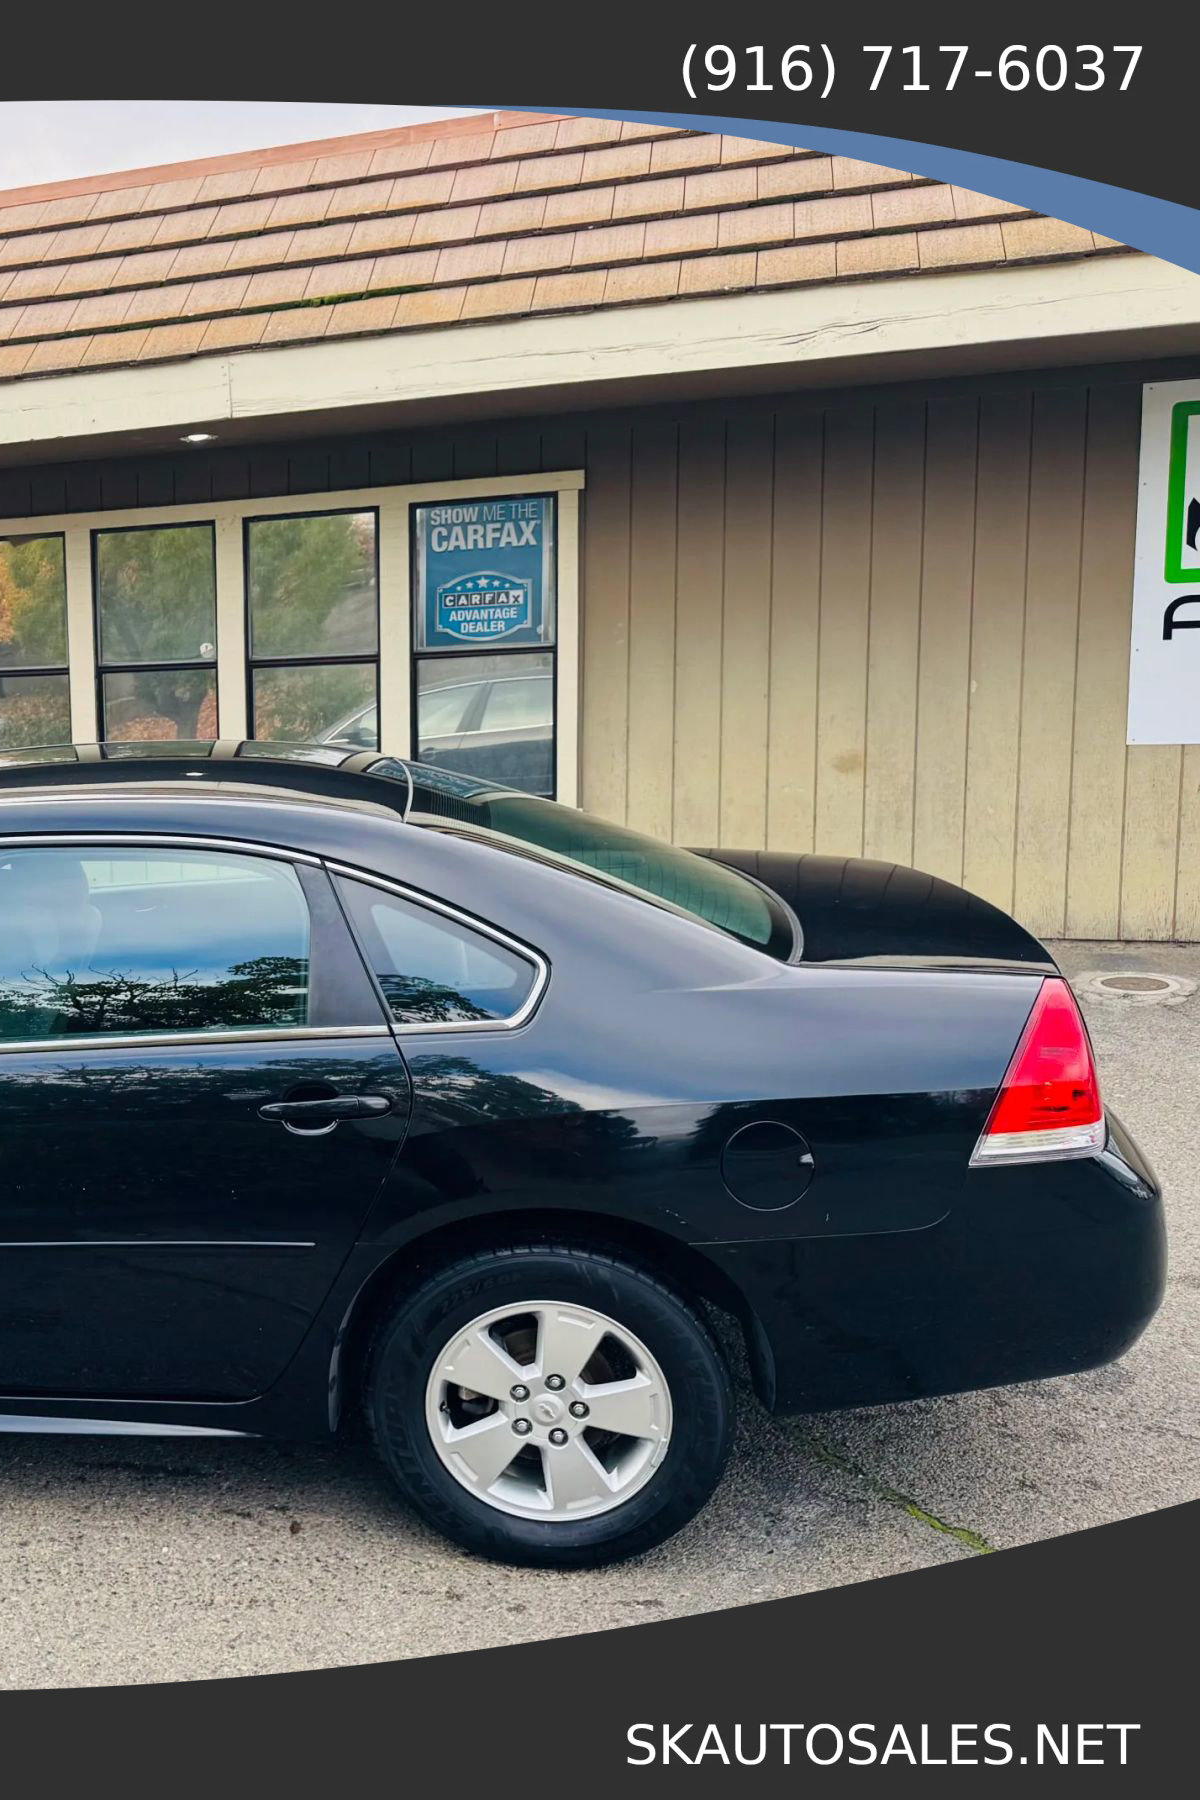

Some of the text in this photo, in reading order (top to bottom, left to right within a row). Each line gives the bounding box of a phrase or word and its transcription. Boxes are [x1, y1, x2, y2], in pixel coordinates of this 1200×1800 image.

[430, 502, 538, 526] SHOW ME THE
[431, 520, 538, 553] CARFAX
[445, 592, 521, 606] CARFAX
[449, 607, 518, 622] ADVANTAGE
[460, 620, 506, 634] DEALER
